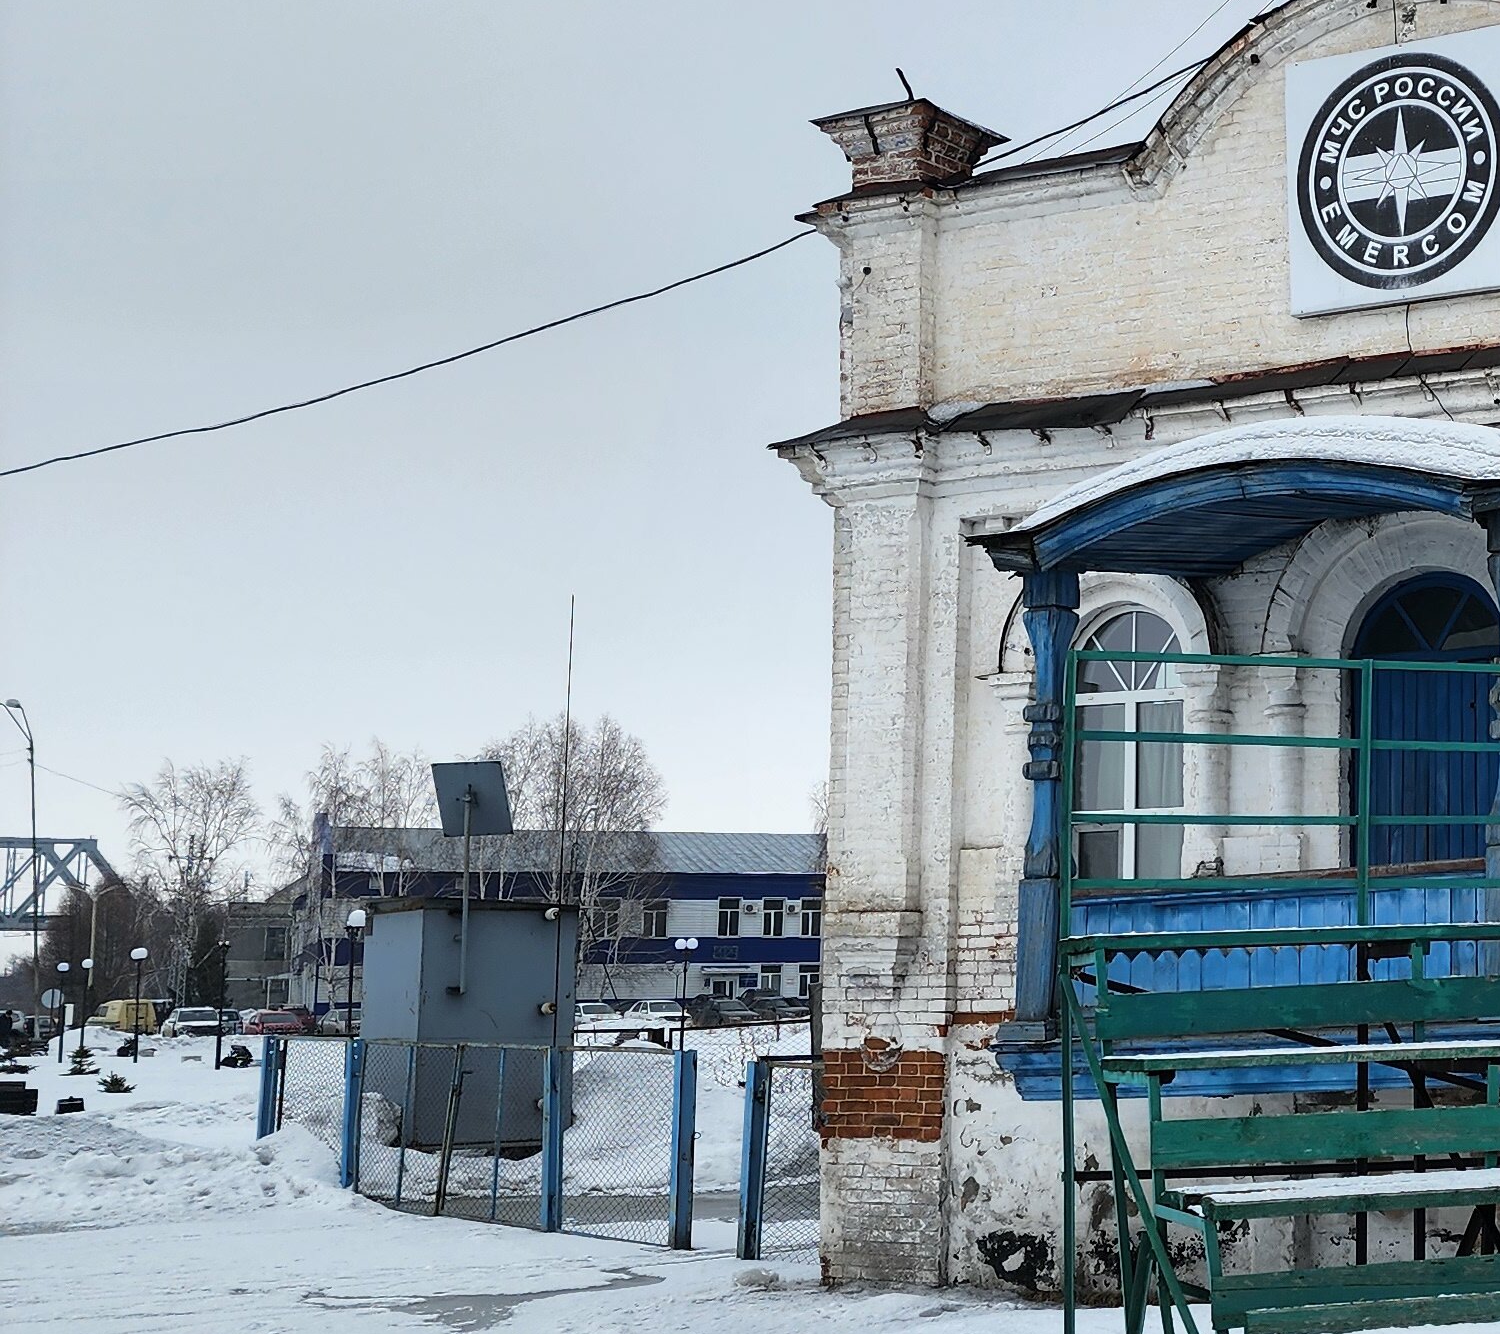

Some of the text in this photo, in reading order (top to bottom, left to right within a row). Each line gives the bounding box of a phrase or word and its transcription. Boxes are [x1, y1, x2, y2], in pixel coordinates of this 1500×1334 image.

[1320, 76, 1484, 164] МЧС РОССИИ
[1321, 179, 1486, 266] EMERCOM
